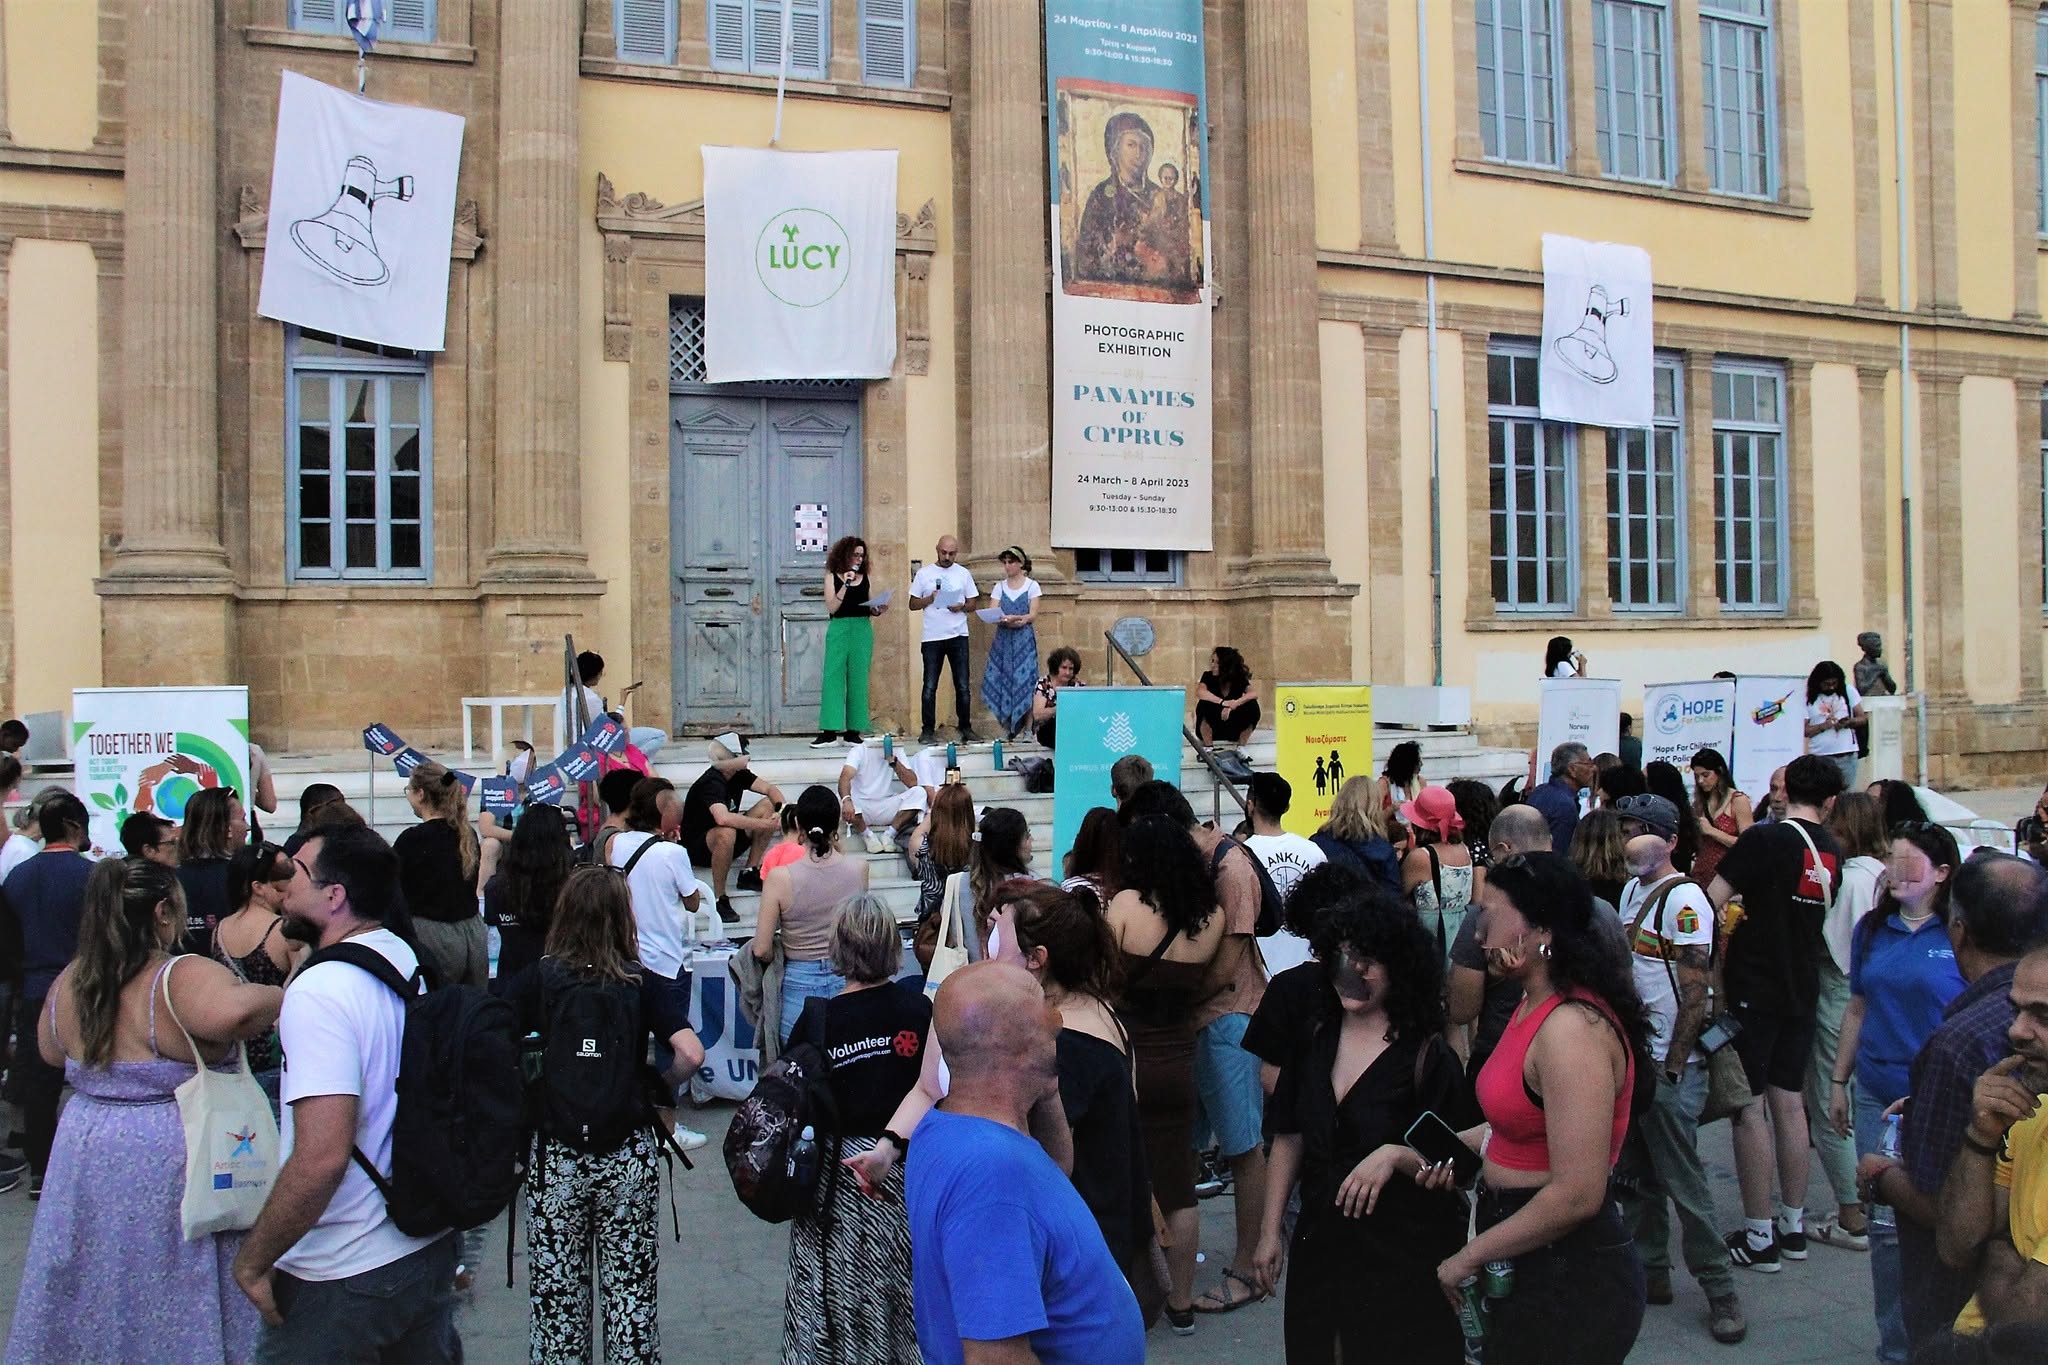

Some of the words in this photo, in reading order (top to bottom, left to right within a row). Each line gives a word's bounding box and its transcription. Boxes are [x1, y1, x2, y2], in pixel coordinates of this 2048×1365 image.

[1054, 15, 1067, 24] 24
[1070, 16, 1112, 30] Μαρτίου
[1121, 24, 1127, 32] 8
[1129, 26, 1174, 39] Απριλίου
[1175, 29, 1198, 43] 2023
[770, 245, 841, 270] LUCY
[1084, 324, 1185, 342] PHOTOGRAPHIC
[1098, 343, 1171, 358] EXHIBITION
[1073, 385, 1195, 408] PANAYIES
[1122, 410, 1147, 424] OF
[1084, 425, 1184, 447] CYPRUS
[1077, 474, 1089, 483] 24
[1093, 475, 1122, 485] March
[1131, 478, 1137, 486] 8
[1140, 477, 1163, 487] April
[1166, 478, 1189, 488] 2023
[1102, 493, 1131, 501] Tuesday
[1139, 494, 1165, 502] Sunday
[1682, 699, 1724, 715] HOPE
[1569, 723, 1590, 732] Norway
[88, 733, 151, 755] TOGETHER
[155, 732, 173, 754] WE
[827, 1036, 891, 1060] Volunteer
